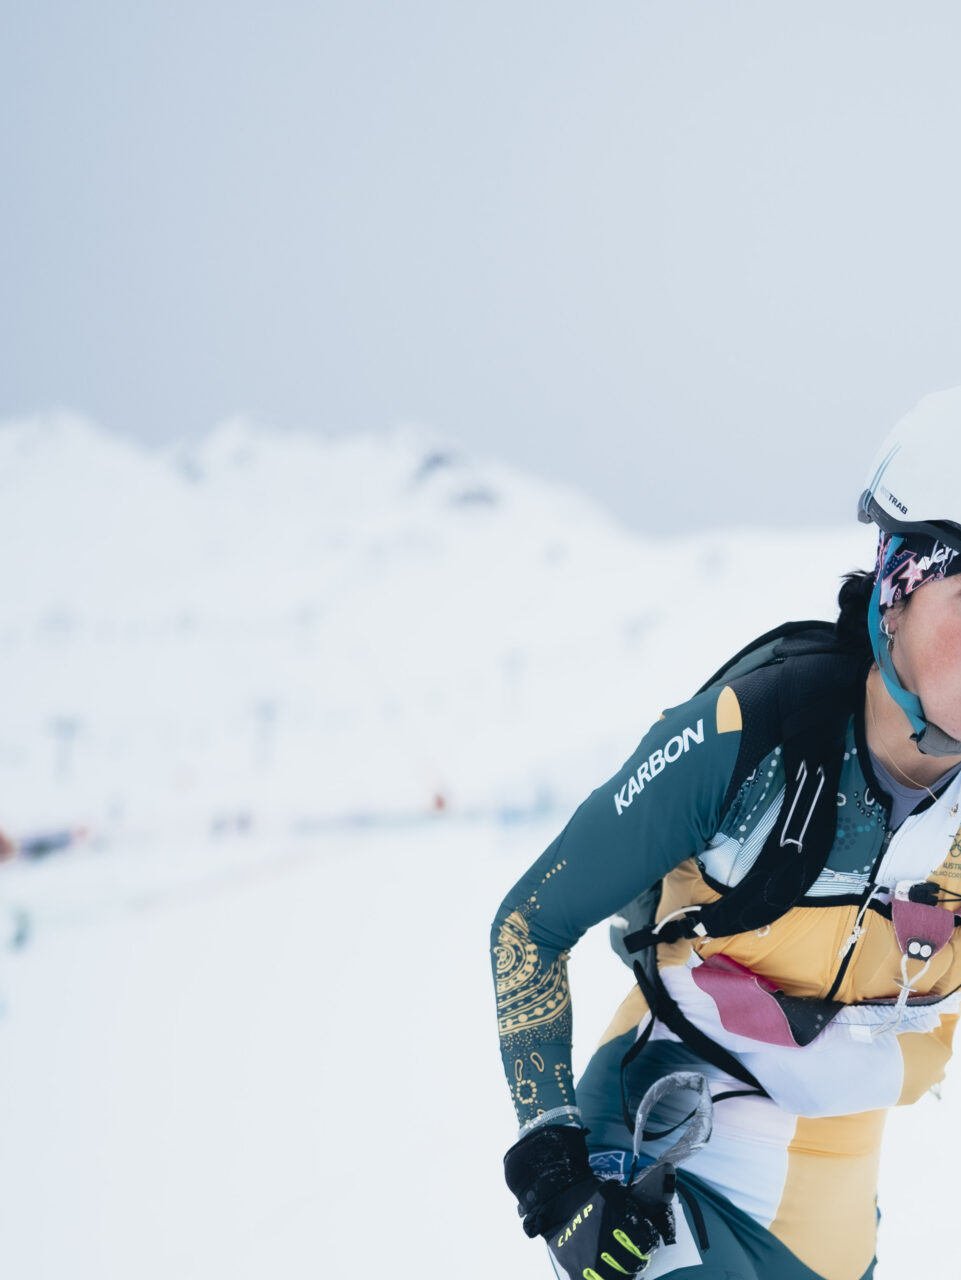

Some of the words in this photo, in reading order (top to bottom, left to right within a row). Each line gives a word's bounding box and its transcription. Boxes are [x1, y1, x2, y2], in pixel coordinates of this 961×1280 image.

[888, 492, 908, 515] TRAB
[614, 718, 705, 816] KARBON
[557, 1203, 593, 1247] CAMP
